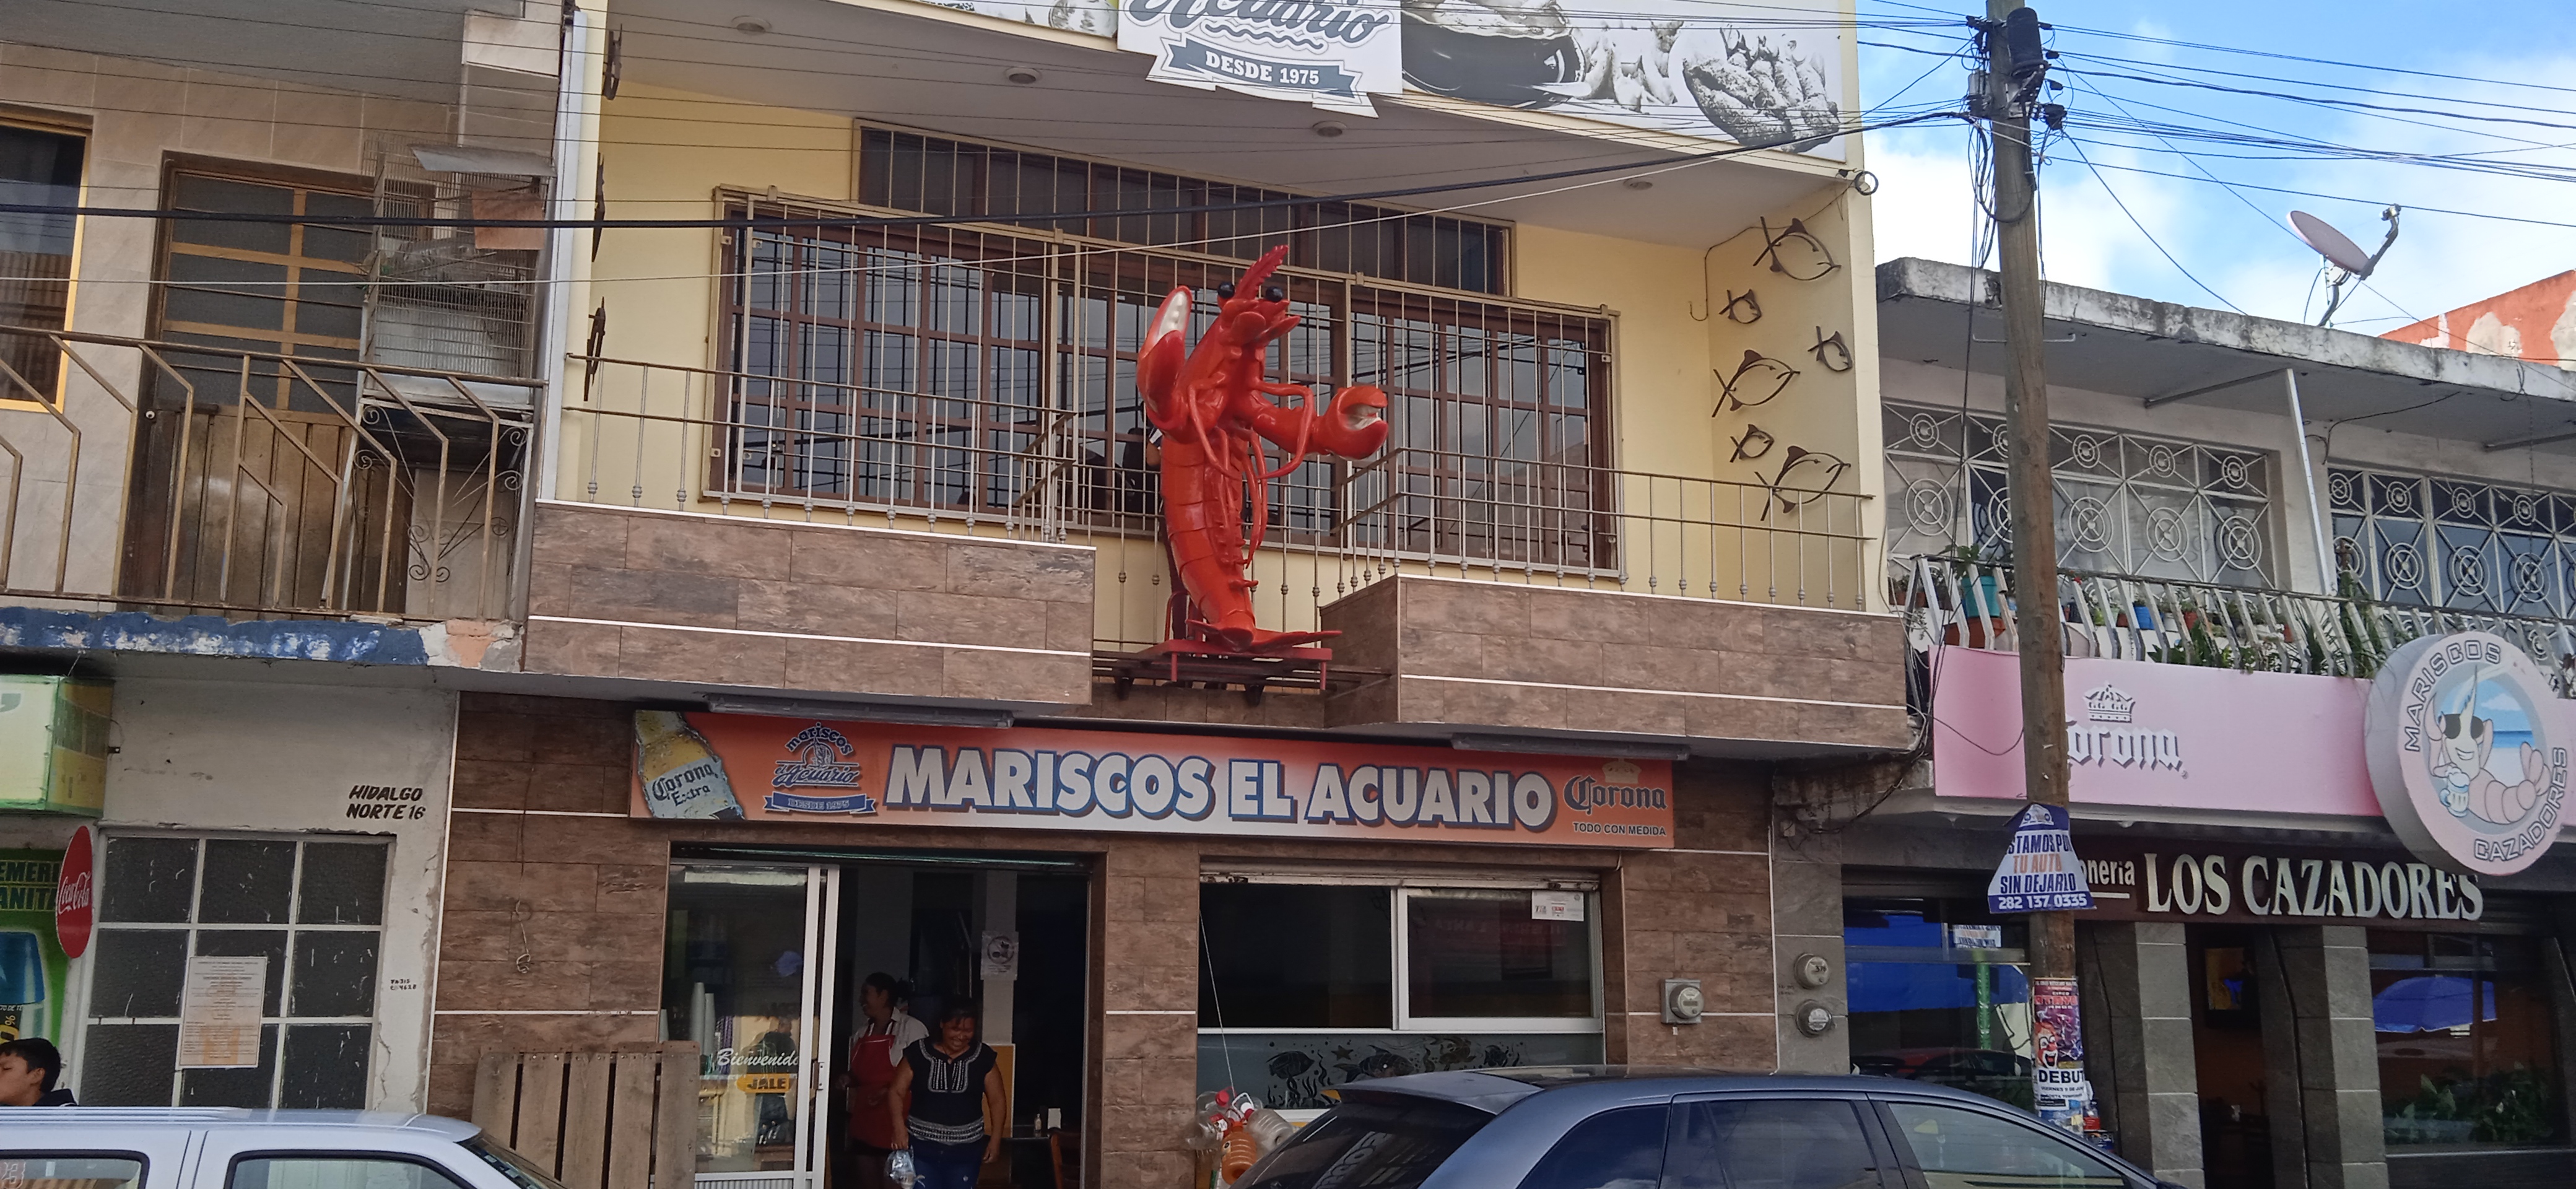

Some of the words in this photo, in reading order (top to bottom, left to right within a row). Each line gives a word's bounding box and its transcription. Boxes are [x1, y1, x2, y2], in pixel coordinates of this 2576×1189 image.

[1206, 51, 1272, 82] DESDE
[1279, 67, 1319, 85] 1975
[2404, 640, 2500, 752] MARISCOS
[785, 721, 853, 756] mariscos
[2066, 715, 2183, 772] orona
[653, 762, 718, 801] Corona
[772, 765, 859, 787] Acuario
[349, 785, 424, 801] HIDALGO
[671, 785, 711, 806] Extra
[884, 745, 1213, 816] MARISCOS
[1229, 759, 1294, 818] EL
[1304, 764, 1554, 829] ACUARIO
[1564, 775, 1668, 816] Corona
[346, 803, 407, 819] NORTE
[409, 805, 426, 820] 16
[788, 798, 824, 810] DESDE
[825, 798, 850, 810] 1975
[2474, 747, 2567, 861] CAZADORES
[1573, 822, 1601, 833] TODO
[1604, 824, 1625, 834] CON
[1629, 825, 1667, 836] MEDIDA
[2008, 834, 2055, 854] STAMOS
[2013, 855, 2028, 874] TU
[2031, 853, 2062, 873] AUTO
[2000, 875, 2021, 894] SIN
[2024, 873, 2076, 893] DEJARLO
[2144, 853, 2230, 915] LOS
[2242, 855, 2483, 921] CAZADORES
[1998, 897, 2022, 910] 282
[2026, 895, 2050, 908] 137
[2053, 894, 2087, 908] 0335
[747, 1078, 786, 1089] JALE
